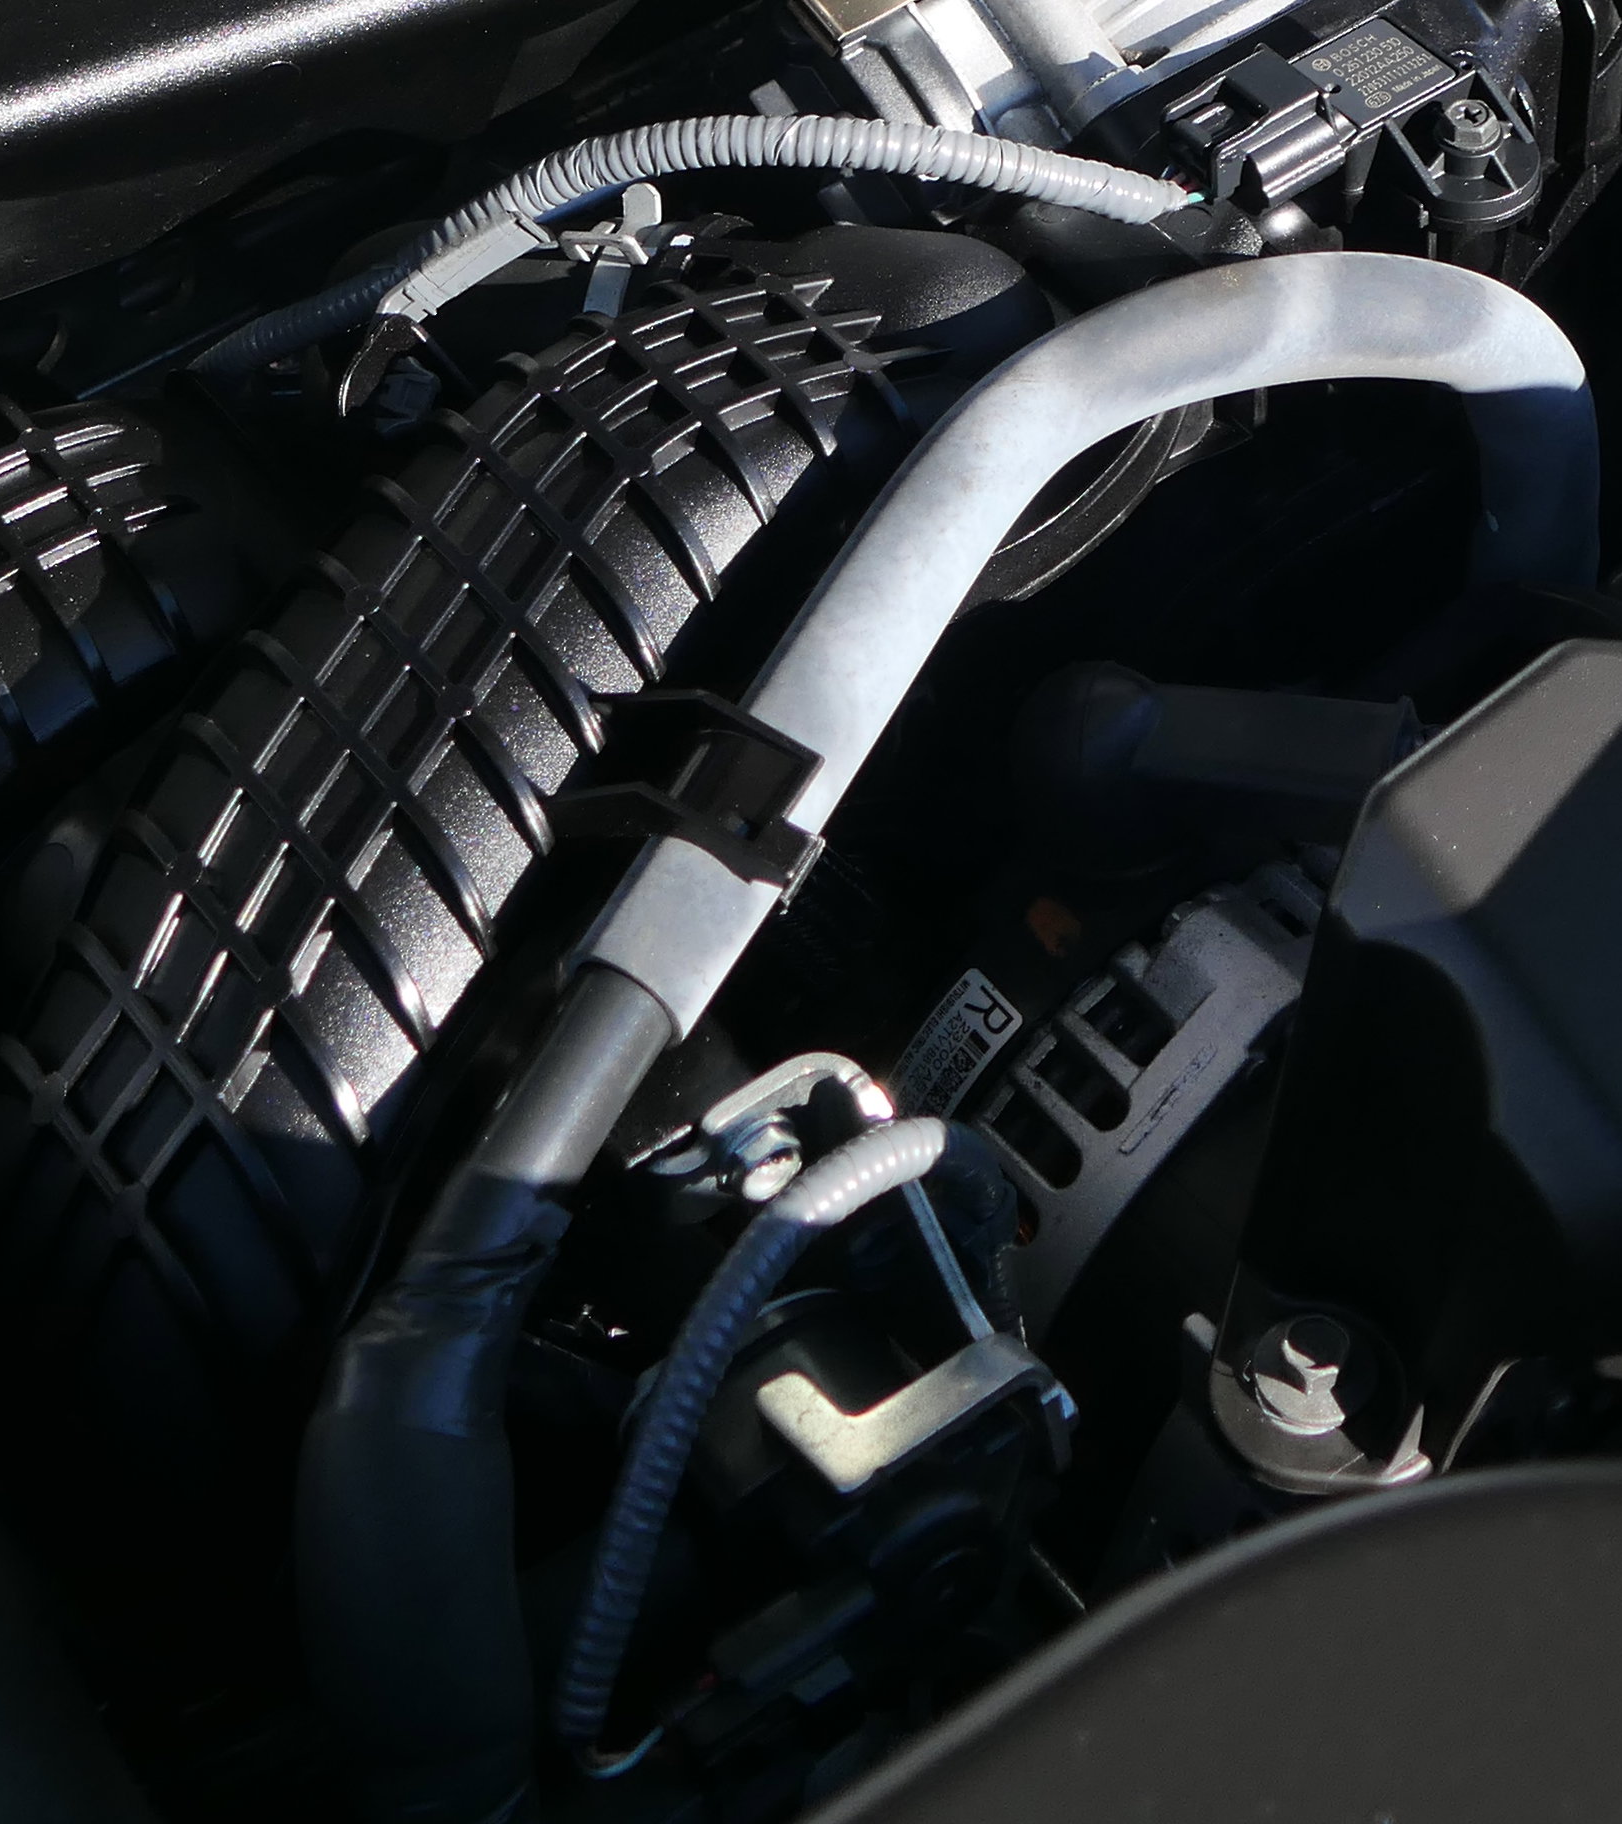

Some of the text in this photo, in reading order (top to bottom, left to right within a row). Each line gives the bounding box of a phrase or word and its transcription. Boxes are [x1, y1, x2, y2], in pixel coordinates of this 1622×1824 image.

[1330, 33, 1377, 62] BOSCH
[1345, 58, 1363, 74] 261
[1364, 47, 1381, 63] 230
[1346, 45, 1415, 87] 22012AA250
[965, 986, 1013, 1034] R
